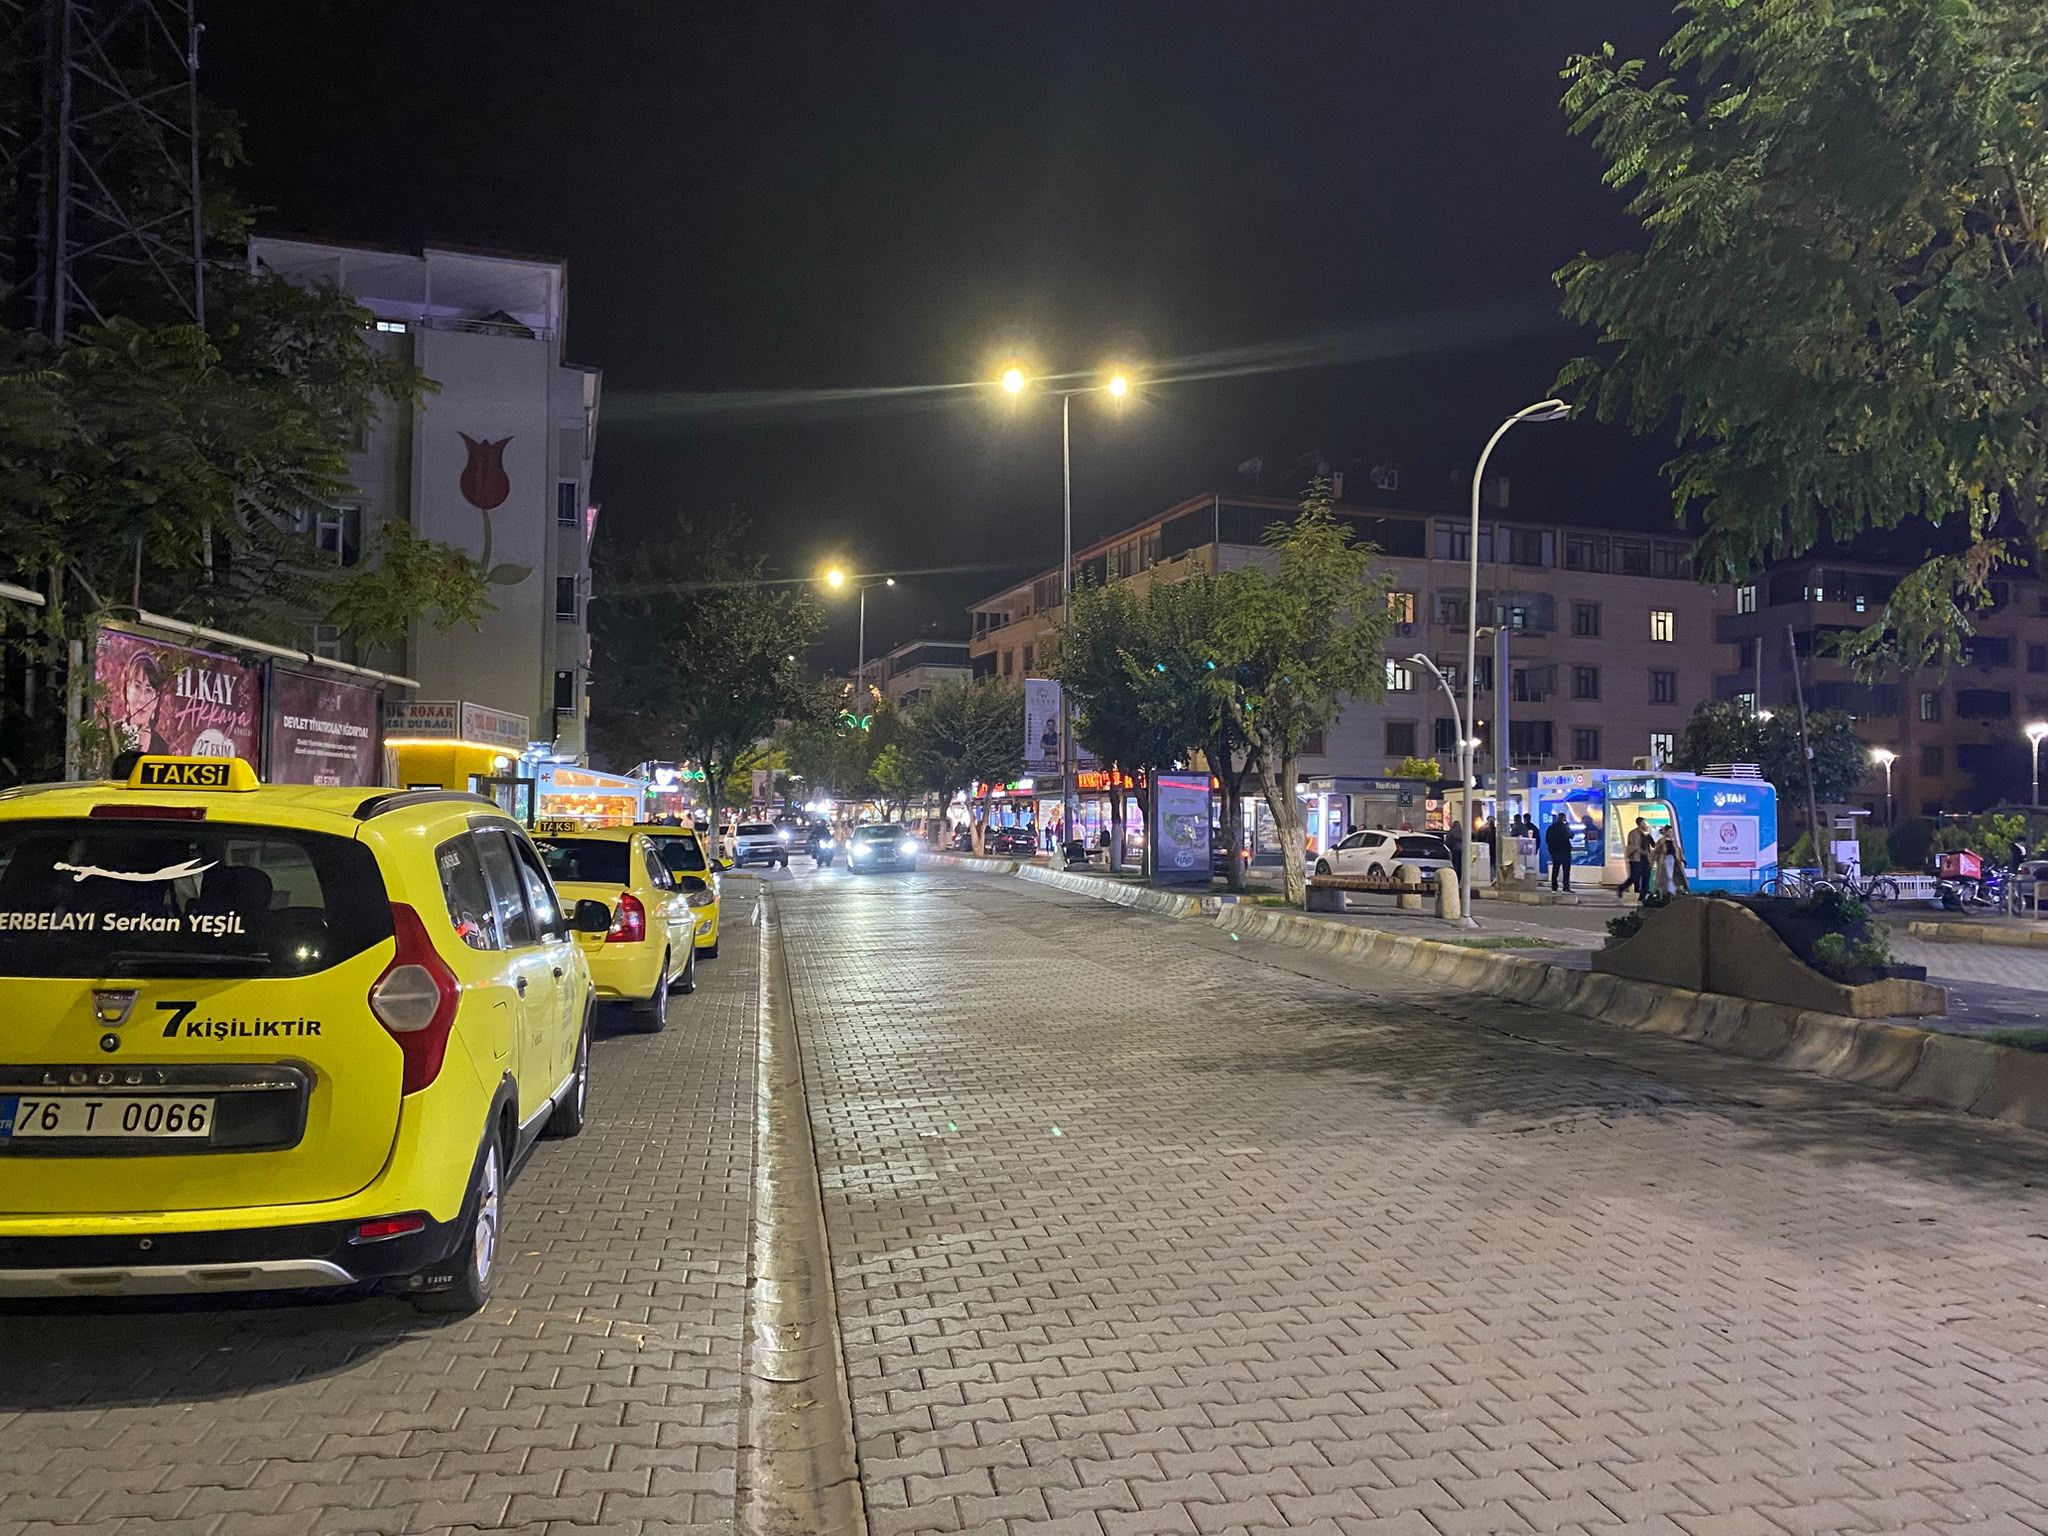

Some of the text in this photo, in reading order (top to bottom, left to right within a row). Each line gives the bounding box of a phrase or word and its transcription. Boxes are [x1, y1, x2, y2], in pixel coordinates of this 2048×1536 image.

[1726, 793, 1747, 803] TAM
[102, 912, 181, 932] Serkan
[188, 911, 246, 937] YEŞİL
[18, 1102, 61, 1130] 76
[85, 1102, 103, 1131] T
[122, 1103, 208, 1133] 0066
